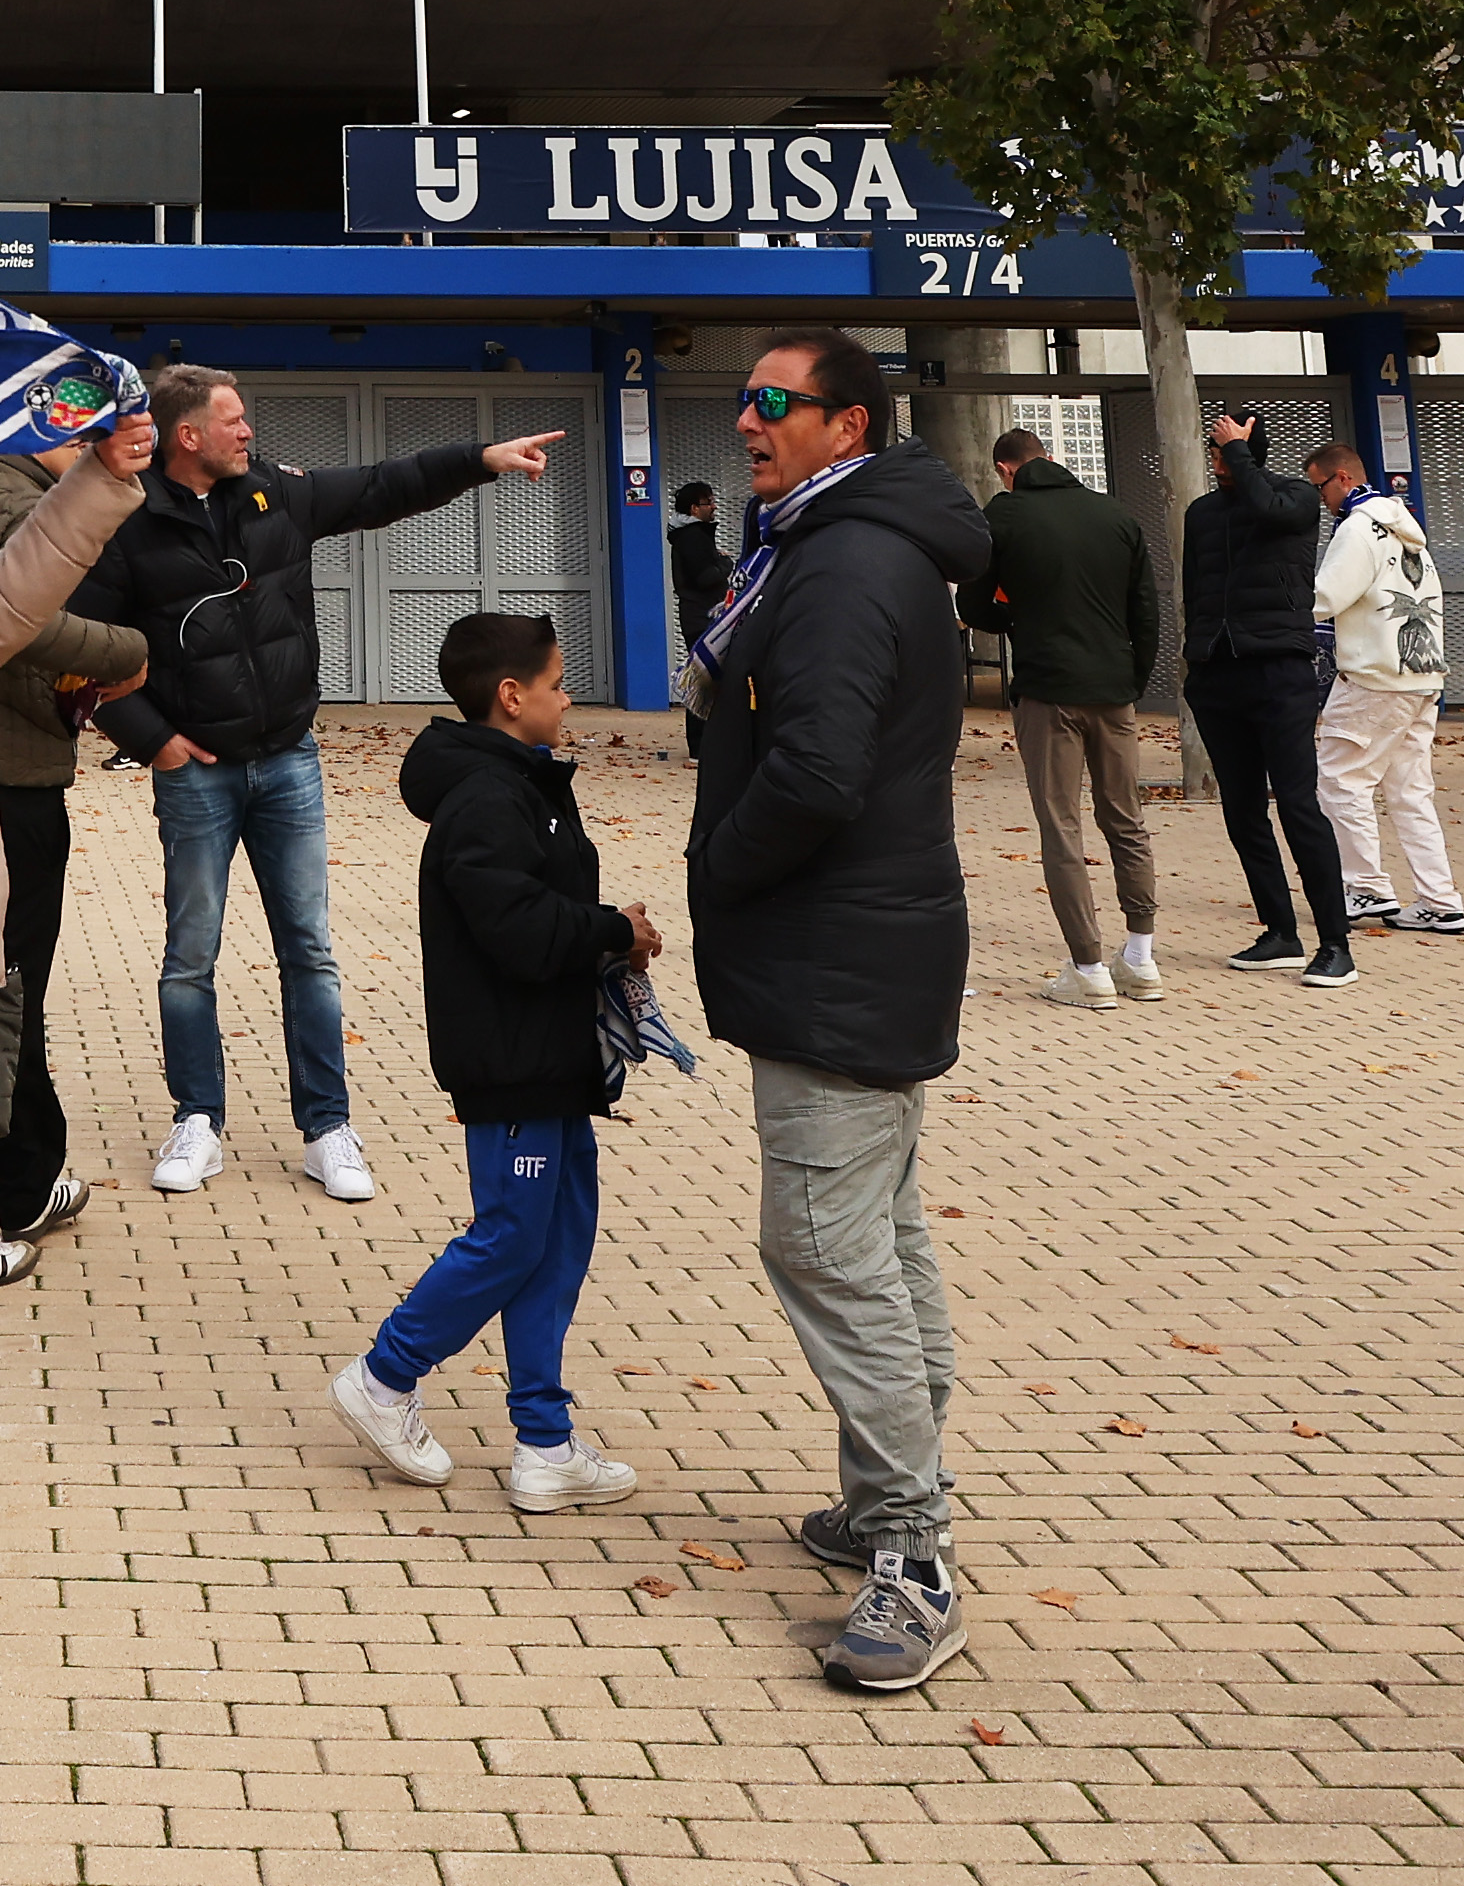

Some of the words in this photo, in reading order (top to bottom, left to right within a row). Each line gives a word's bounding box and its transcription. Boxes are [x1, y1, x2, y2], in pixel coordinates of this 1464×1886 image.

[546, 136, 918, 221] LUJISA
[625, 348, 643, 381] 2
[1380, 353, 1399, 386] 4
[514, 1156, 547, 1179] GTF
